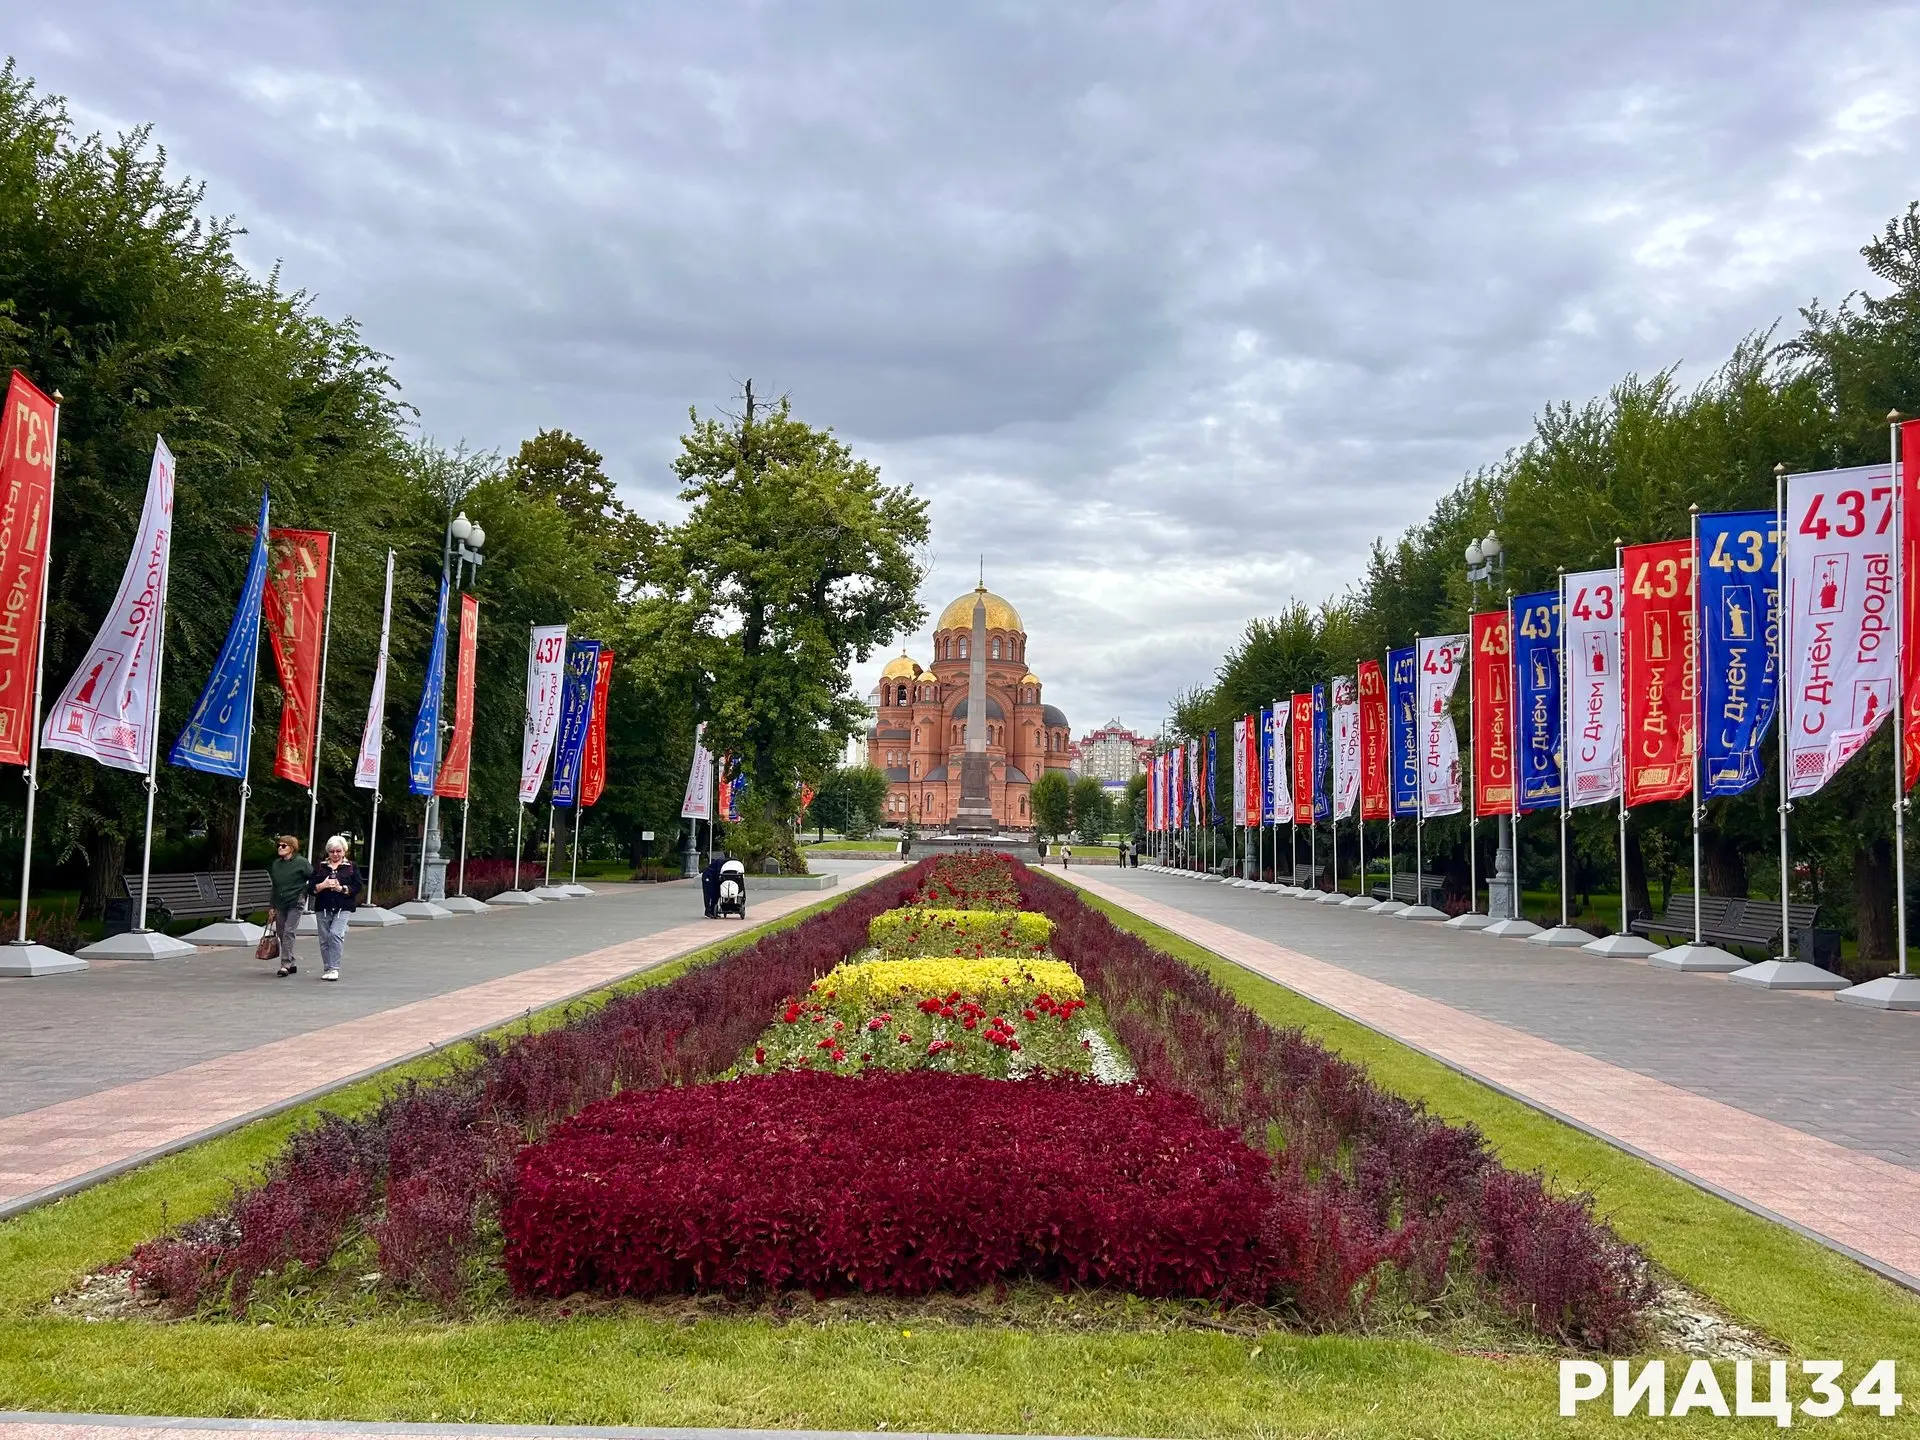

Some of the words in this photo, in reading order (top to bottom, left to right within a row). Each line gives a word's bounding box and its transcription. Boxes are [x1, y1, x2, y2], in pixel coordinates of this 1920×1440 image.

[1799, 489, 1901, 540] 437
[1857, 553, 1893, 664] города!
[536, 637, 563, 664] 437
[596, 661, 609, 684] 37
[1804, 621, 1834, 705] Днём
[1643, 667, 1667, 735] Днём
[1723, 648, 1748, 723] Днём
[1490, 708, 1508, 761] Днём
[1531, 695, 1549, 750] Днём
[1583, 682, 1604, 741] Днём
[1803, 711, 1825, 735] С
[1428, 721, 1440, 767] Днём
[1533, 755, 1548, 770] С
[1581, 746, 1596, 762] С
[1643, 740, 1662, 758] С
[1404, 775, 1416, 786] С
[1490, 765, 1505, 778] С
